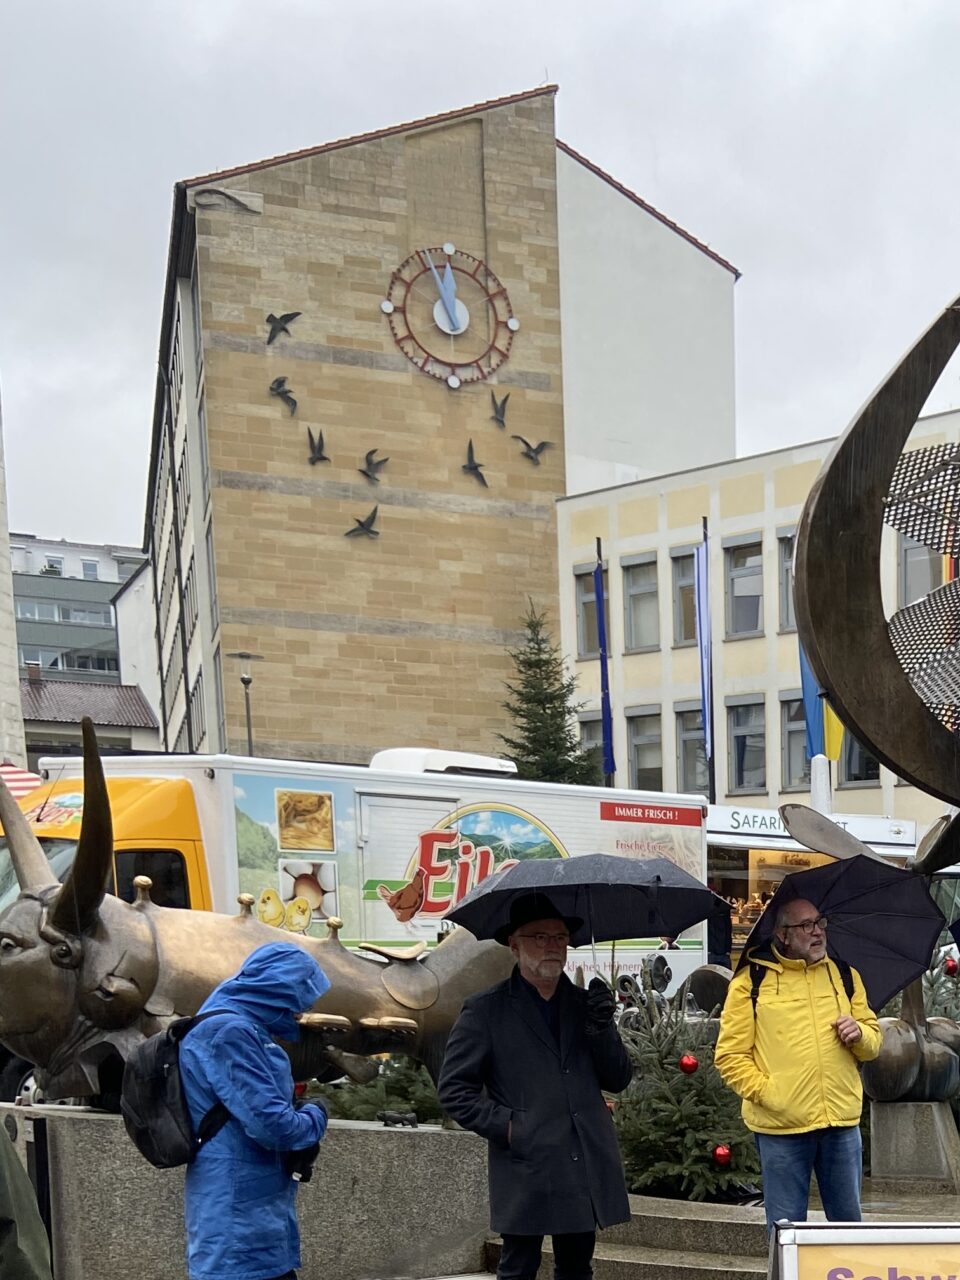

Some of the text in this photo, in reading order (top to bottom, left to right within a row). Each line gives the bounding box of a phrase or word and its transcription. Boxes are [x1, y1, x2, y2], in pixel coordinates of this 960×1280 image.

[615, 807, 643, 818] IMMER
[645, 809, 673, 820] FRISCH
[418, 830, 519, 917] Eil
